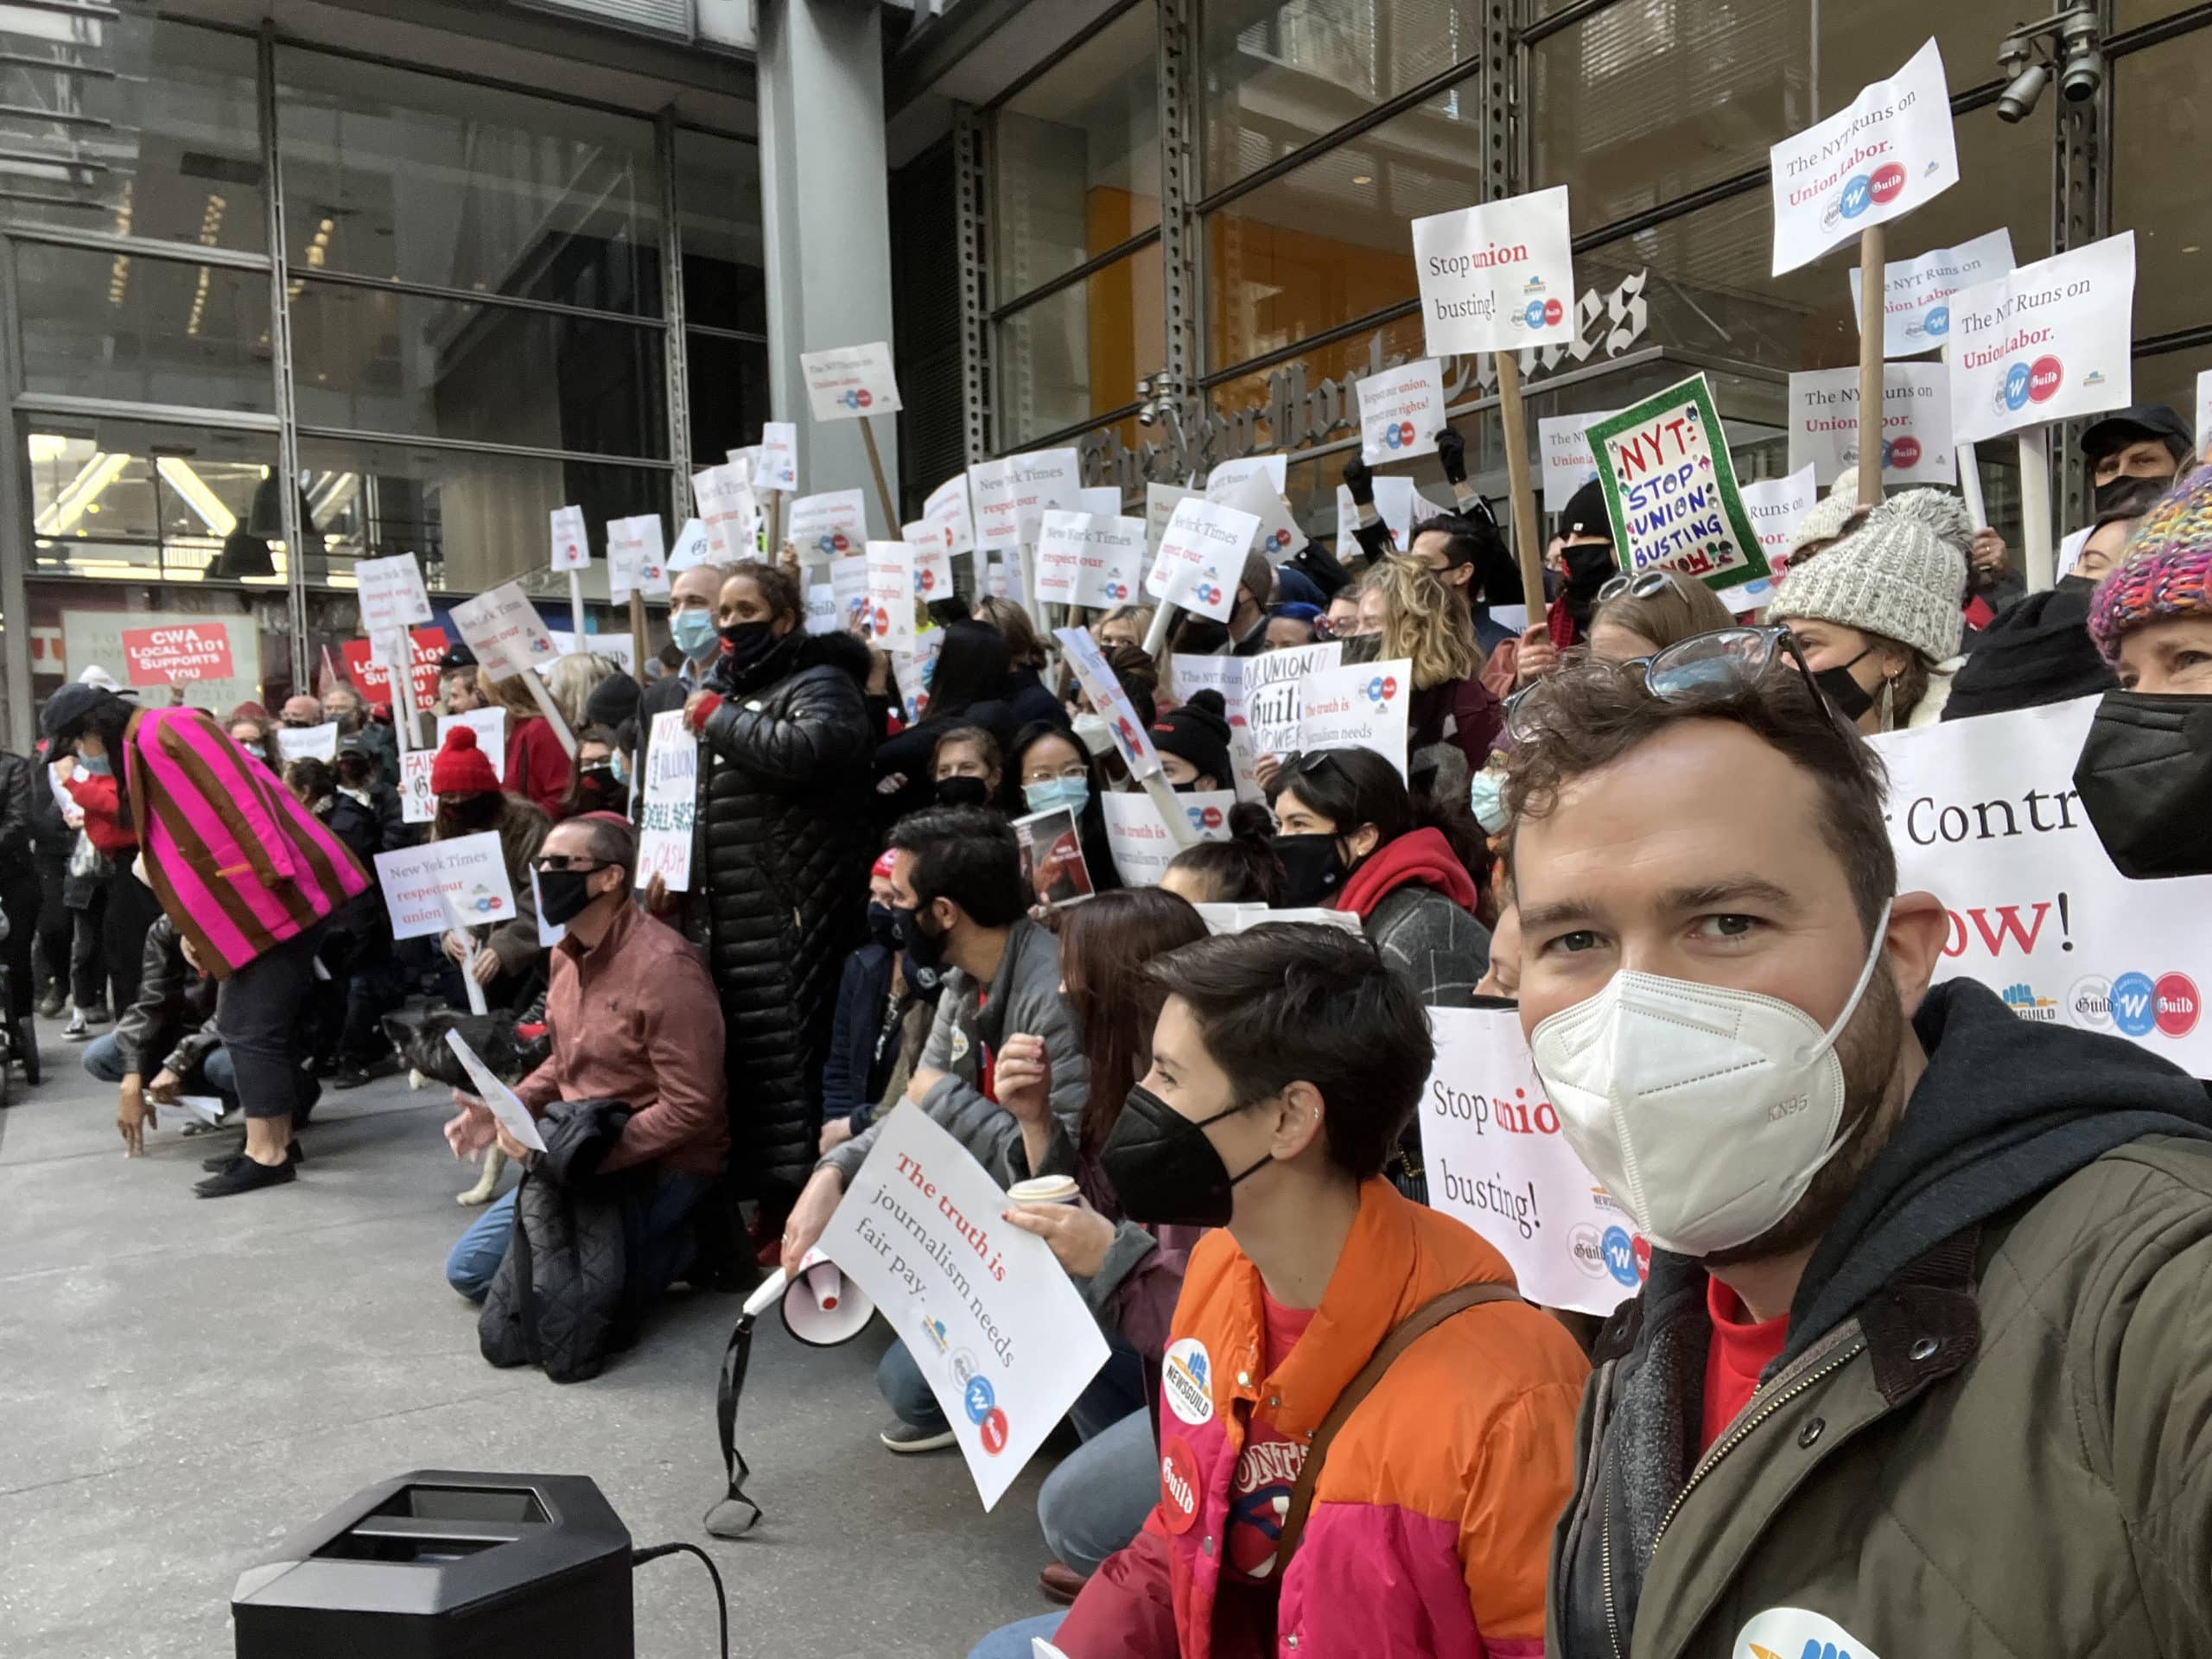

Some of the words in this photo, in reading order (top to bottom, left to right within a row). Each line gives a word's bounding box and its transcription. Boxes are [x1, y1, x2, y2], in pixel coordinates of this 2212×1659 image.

[1787, 156, 1819, 178] The
[1821, 130, 1851, 161] NYT
[1851, 105, 1895, 136] Runs
[1898, 91, 1917, 112] on
[1789, 175, 1839, 207] Union
[1840, 139, 1895, 177] Labor.
[1872, 174, 1903, 194] Guild
[1429, 256, 1470, 278] Stop
[1471, 242, 1529, 270] union
[1893, 276, 1923, 292] NYT
[1926, 265, 1960, 283] Runs
[1963, 258, 1982, 270] on
[1435, 289, 1497, 321] busting!
[1884, 299, 1914, 315] nion
[1961, 312, 1993, 334] The
[2016, 287, 2063, 313] Runs
[2067, 278, 2091, 299] on
[1963, 344, 2005, 370] Union
[2005, 326, 2056, 354] Labor.
[2031, 372, 2058, 390] Guild
[1805, 391, 1836, 406] The
[1883, 387, 1915, 401] uns
[1917, 387, 1934, 397] on
[1805, 416, 1858, 432] Union
[1549, 433, 1571, 446] The
[1619, 417, 1697, 482] NYT:
[1552, 453, 1585, 467] Union
[1023, 467, 1064, 481] Times
[1629, 463, 1694, 512] STOP
[1017, 496, 1039, 507] our
[1634, 486, 1707, 537] UNION
[1750, 503, 1790, 520] Runs
[1095, 531, 1131, 546] Times
[1204, 522, 1238, 546] Times
[1635, 514, 1724, 569] BUSTING
[1079, 556, 1104, 568] our
[1182, 547, 1203, 563] our
[130, 645, 180, 659] LOCAL
[185, 639, 224, 652] 1101
[150, 628, 200, 646] CWA
[139, 654, 220, 671] SUPPORTS
[1263, 652, 1313, 681] UNION
[1181, 671, 1200, 683] The
[1220, 671, 1244, 685] Run
[1317, 701, 1341, 716] truth
[1341, 699, 1350, 712] is
[1341, 723, 1374, 741] needs
[1908, 787, 2080, 846] Contr
[1128, 824, 1154, 840] truth
[1154, 824, 1166, 839] is
[389, 867, 420, 880] New
[447, 852, 487, 868] Times
[655, 842, 686, 874] CASH
[1942, 892, 2074, 957] ow!
[2075, 996, 2114, 1014] Guild
[2120, 995, 2149, 1019] W
[2157, 998, 2194, 1014] Guild
[1433, 1078, 1489, 1135] Stop
[1493, 1087, 1560, 1135] unio
[1766, 1096, 1808, 1123] KN95
[1440, 1159, 1541, 1240] busting!
[897, 1152, 938, 1199] The
[938, 1195, 990, 1263] truth
[988, 1253, 1008, 1284] is
[855, 1218, 889, 1258] fair
[887, 1256, 927, 1304] pay.
[1611, 1245, 1630, 1270] W
[869, 1185, 970, 1300] journalism
[969, 1295, 1016, 1370] needs
[1166, 1364, 1210, 1417] NEWSGUILD
[1163, 1456, 1195, 1515] Guild
